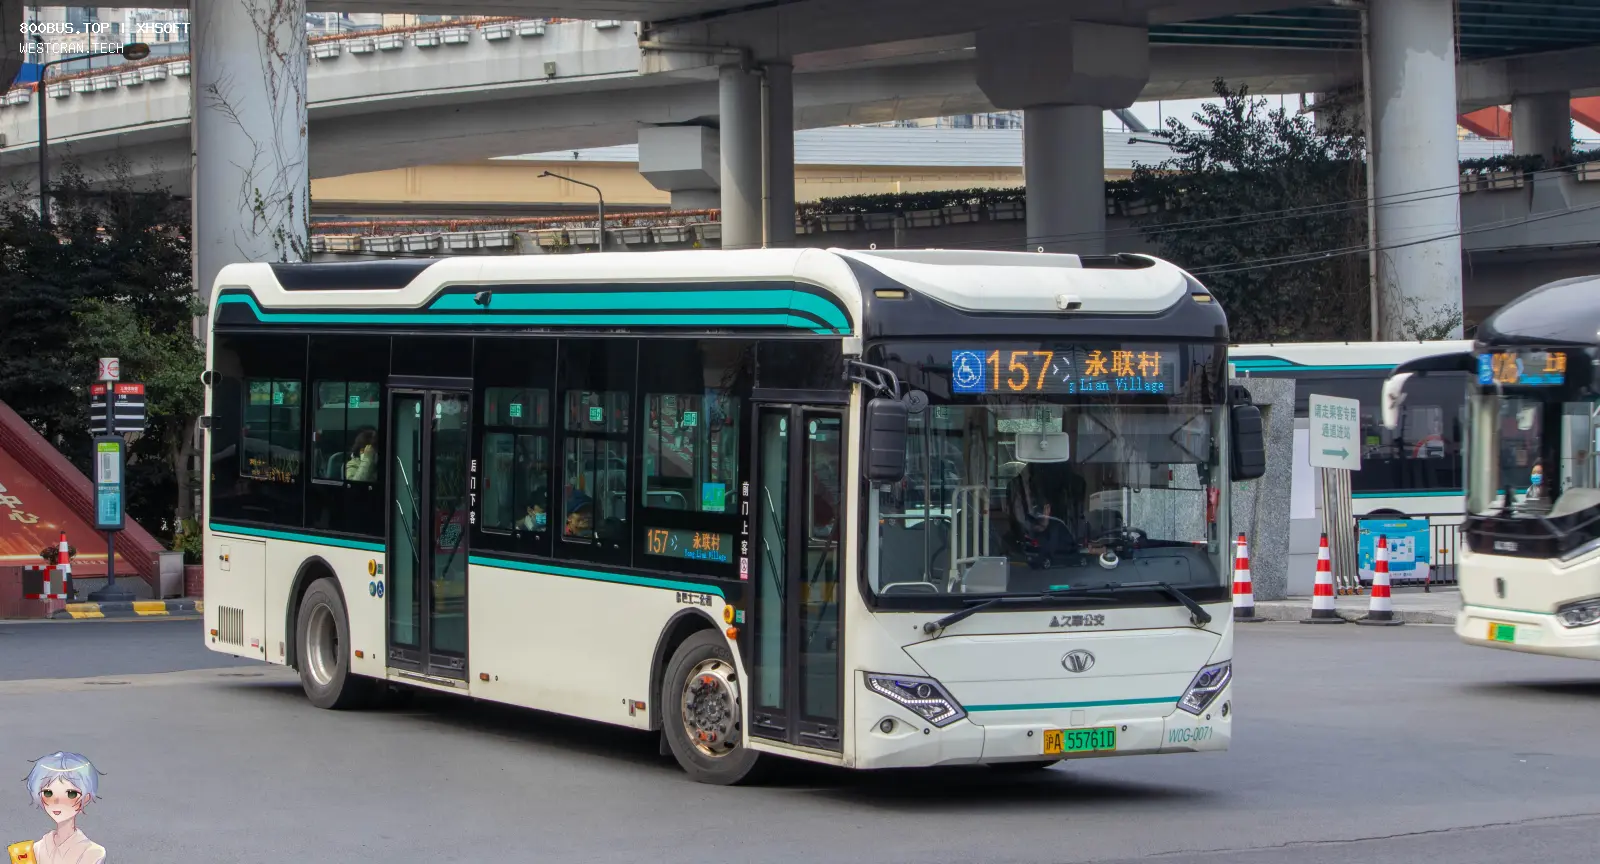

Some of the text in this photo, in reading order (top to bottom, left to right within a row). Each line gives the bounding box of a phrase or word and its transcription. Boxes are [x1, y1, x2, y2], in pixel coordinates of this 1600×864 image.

[986, 350, 1054, 391] 157
[1084, 350, 1162, 377] 永联村
[1080, 377, 1110, 391] Lian
[1115, 377, 1164, 393] Village
[1314, 404, 1356, 422] 请走乘客专用
[1321, 423, 1350, 440] 通道进站
[469, 459, 477, 525] 后门下客
[741, 481, 749, 555] 前门上客
[647, 528, 669, 554] 157
[692, 531, 721, 551] 永联村
[1067, 729, 1116, 750] 55761D
